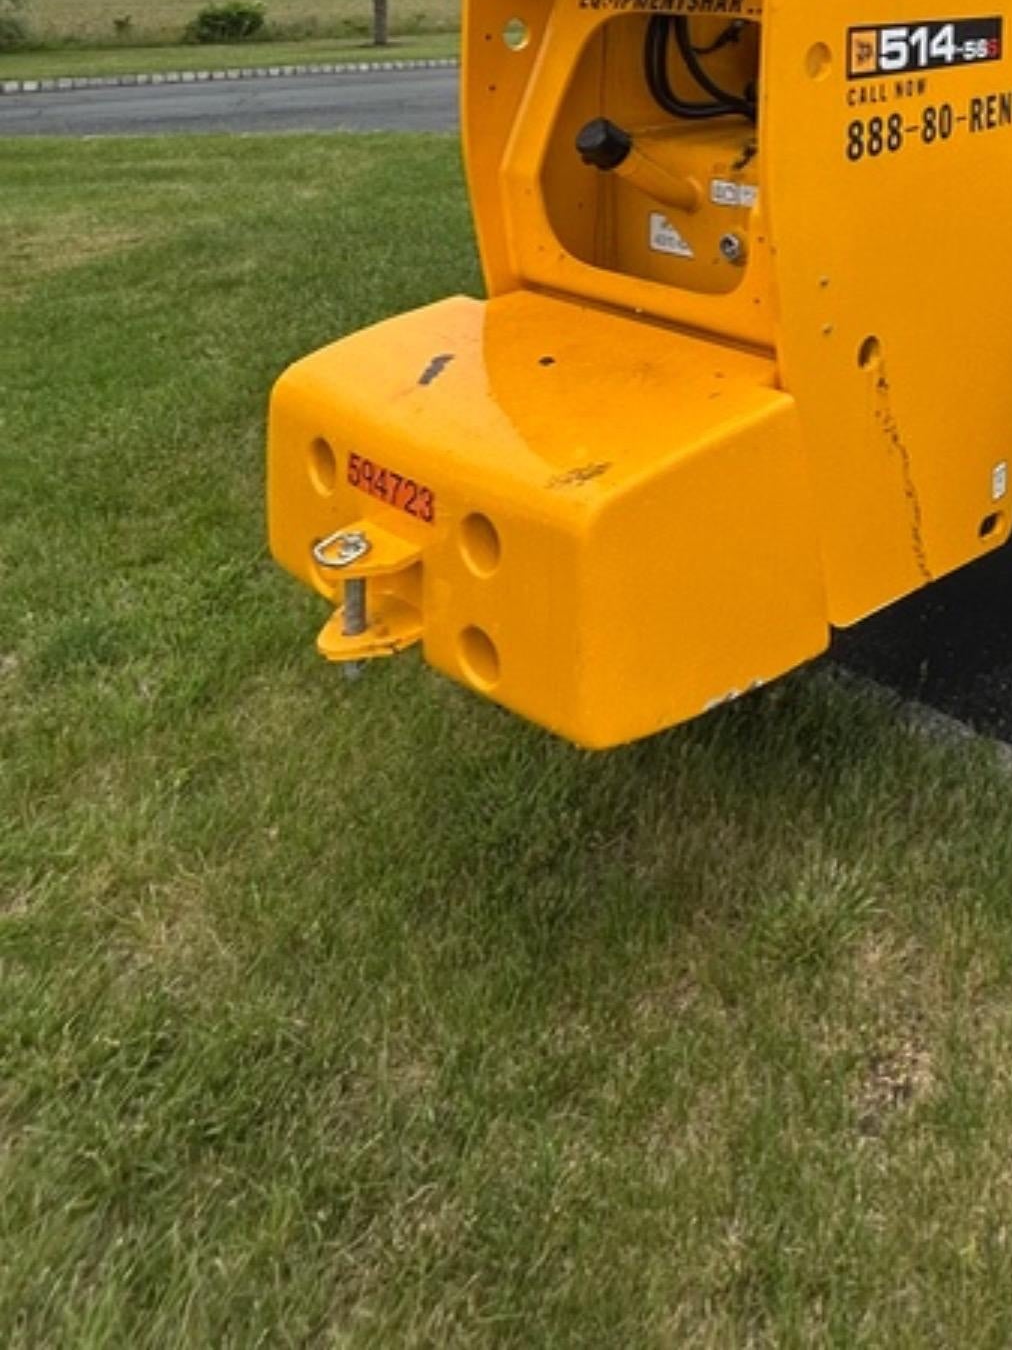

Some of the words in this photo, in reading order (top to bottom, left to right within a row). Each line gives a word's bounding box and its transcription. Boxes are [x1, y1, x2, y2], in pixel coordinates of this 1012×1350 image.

[847, 83, 887, 106] CALL
[895, 78, 926, 98] NOW
[347, 451, 435, 523] 594723
